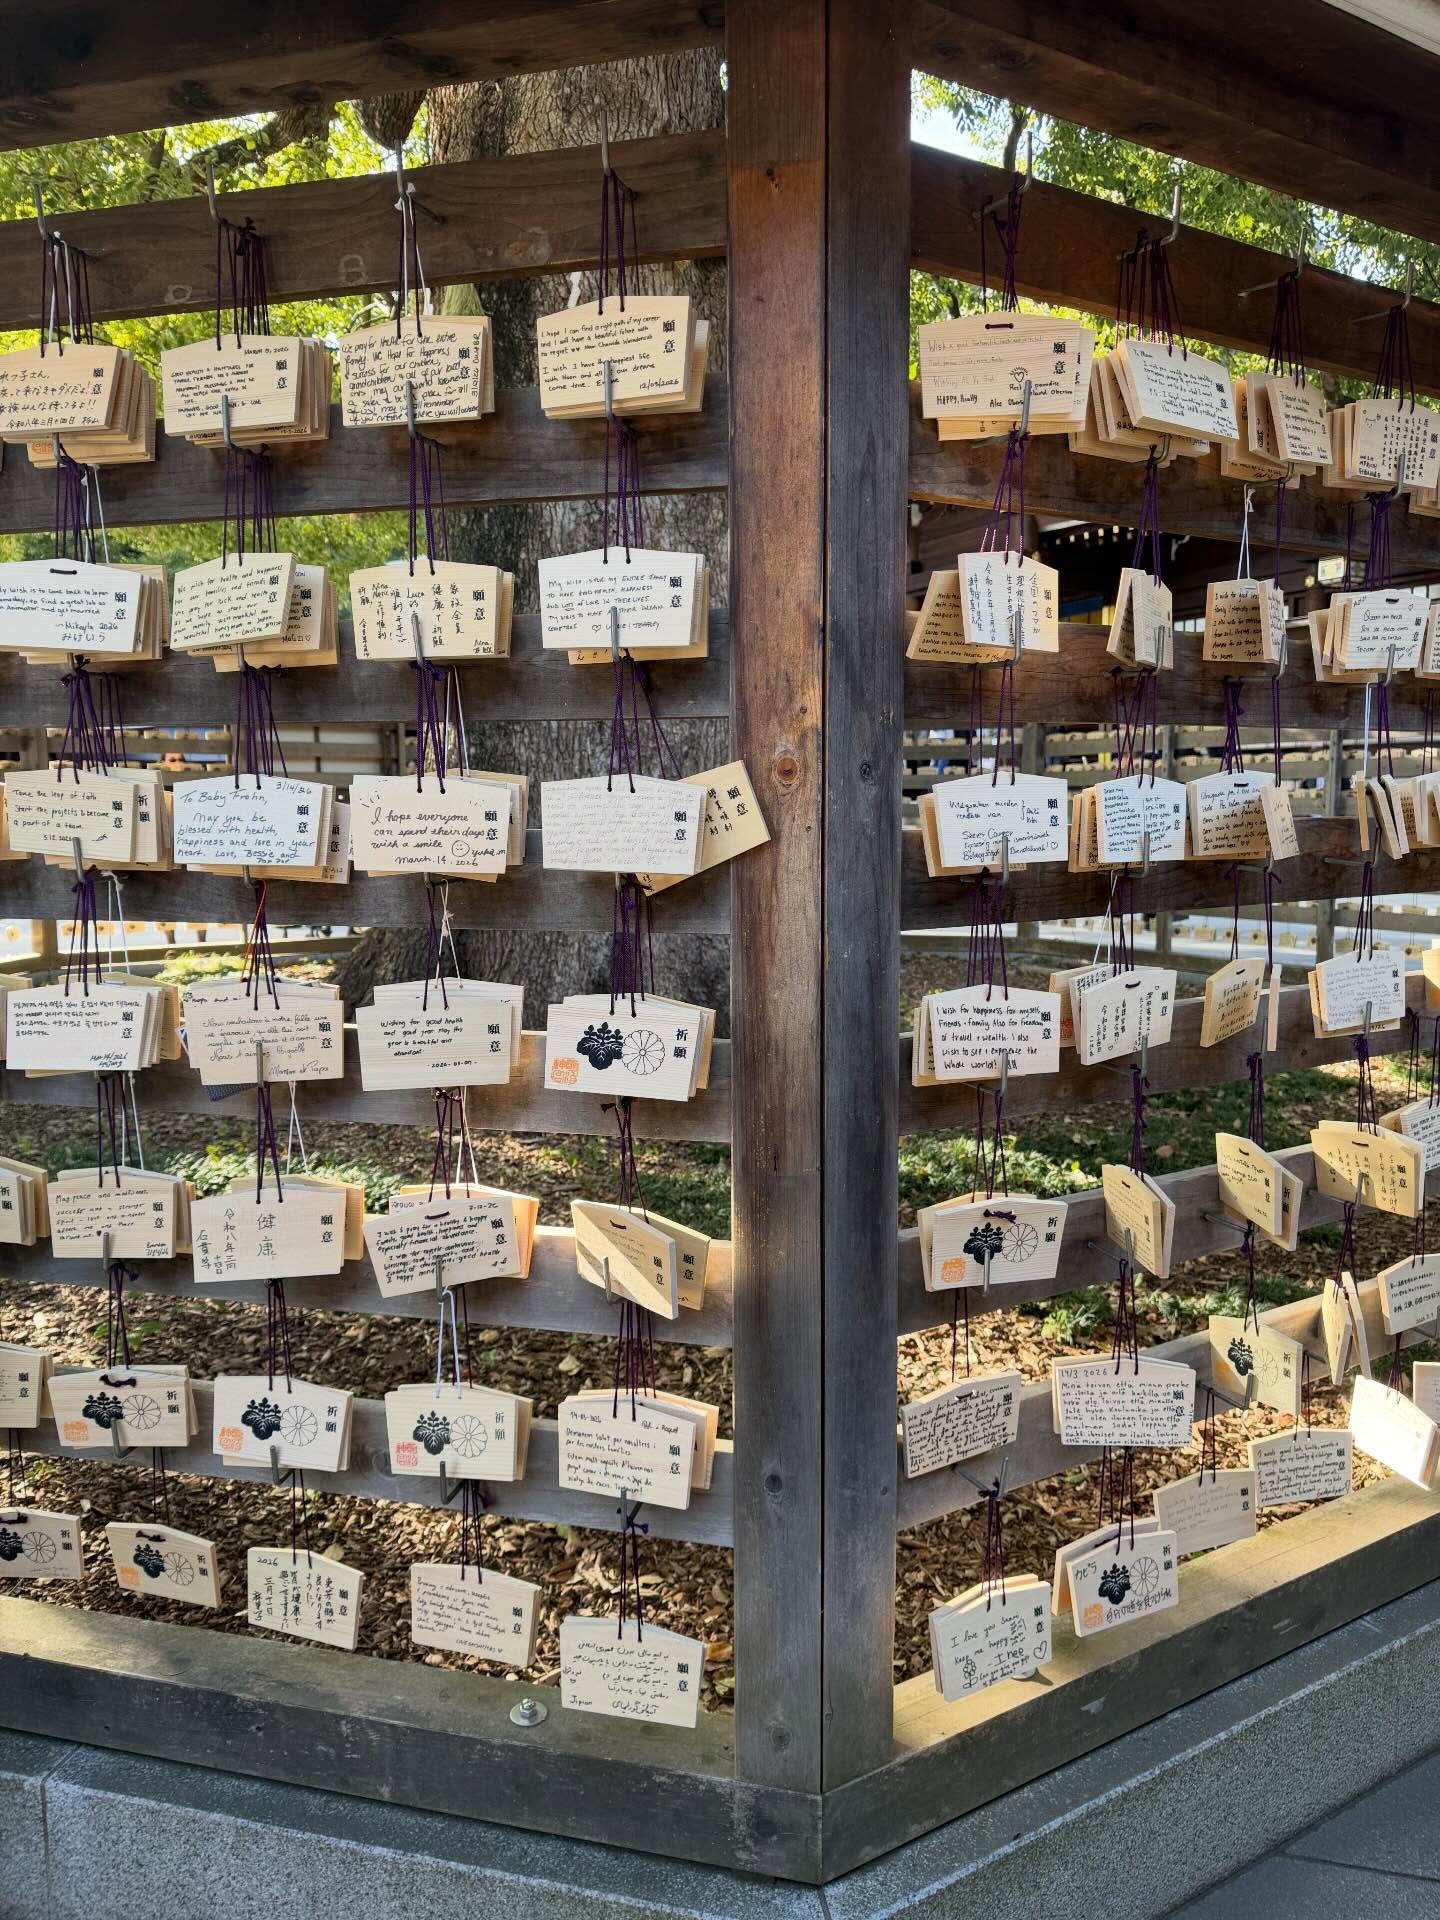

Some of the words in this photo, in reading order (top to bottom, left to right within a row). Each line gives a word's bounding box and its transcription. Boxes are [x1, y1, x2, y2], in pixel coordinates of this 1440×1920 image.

[595, 331, 617, 340] beautiful
[663, 320, 675, 353] 願意
[550, 348, 568, 357] regret
[928, 340, 946, 351] Wish
[1053, 342, 1066, 374] 願意
[553, 364, 567, 372] wish
[633, 363, 655, 372] dreams
[549, 384, 567, 392] come
[275, 782, 312, 795] 3/14/26
[180, 790, 197, 803] To
[199, 792, 226, 807] Baby
[51, 808, 78, 818] projects
[112, 801, 123, 829] 願意
[193, 813, 220, 825] May
[224, 815, 243, 826] you
[252, 813, 267, 822] be
[297, 805, 309, 834] 願意
[371, 807, 381, 825] I
[385, 810, 411, 823] hope
[417, 812, 468, 824] everyone
[178, 825, 211, 835] blessed
[398, 827, 427, 839] spend
[431, 827, 461, 836] their
[462, 827, 485, 838] days
[485, 811, 498, 840] 願意
[674, 811, 687, 841] 願意
[177, 839, 224, 849] happiness
[229, 839, 247, 847] and
[255, 839, 271, 847] love
[275, 839, 285, 847] in
[289, 841, 315, 854] your
[371, 840, 399, 848] with
[413, 840, 443, 848] smile
[244, 850, 274, 858] Bessie
[942, 1006, 956, 1014] wish
[960, 1004, 969, 1014] for
[972, 1006, 1002, 1016] happiness
[1006, 1006, 1016, 1014] for
[381, 1020, 405, 1028] Wishing
[1040, 1012, 1052, 1040] 願意
[388, 1040, 401, 1049] year
[488, 1024, 501, 1053] 願意
[673, 1028, 688, 1059] 祈願
[951, 1033, 972, 1041] travel
[942, 1048, 960, 1056] wish
[971, 1048, 982, 1056] see
[970, 1060, 997, 1069] world!
[1397, 1165, 1408, 1188] 願意
[72, 1193, 91, 1204] peace
[257, 1213, 277, 1257] 健康
[321, 1214, 333, 1243] 願意
[1044, 1216, 1059, 1243] 祈願
[682, 1253, 694, 1281] 願意
[1084, 1368, 1108, 1377] 2026
[18, 1372, 29, 1398] 願意
[167, 1390, 180, 1414] 祈願
[325, 1404, 338, 1433] 祈願
[494, 1411, 505, 1441] 祈願
[60, 1529, 73, 1551] 祈願
[257, 1557, 278, 1566] 2026
[1162, 1544, 1173, 1570] 祈願
[197, 1554, 208, 1577] 祈願
[952, 1636, 959, 1648] I
[964, 1630, 978, 1642] love
[984, 1624, 996, 1637] you
[989, 1637, 1008, 1649] happy
